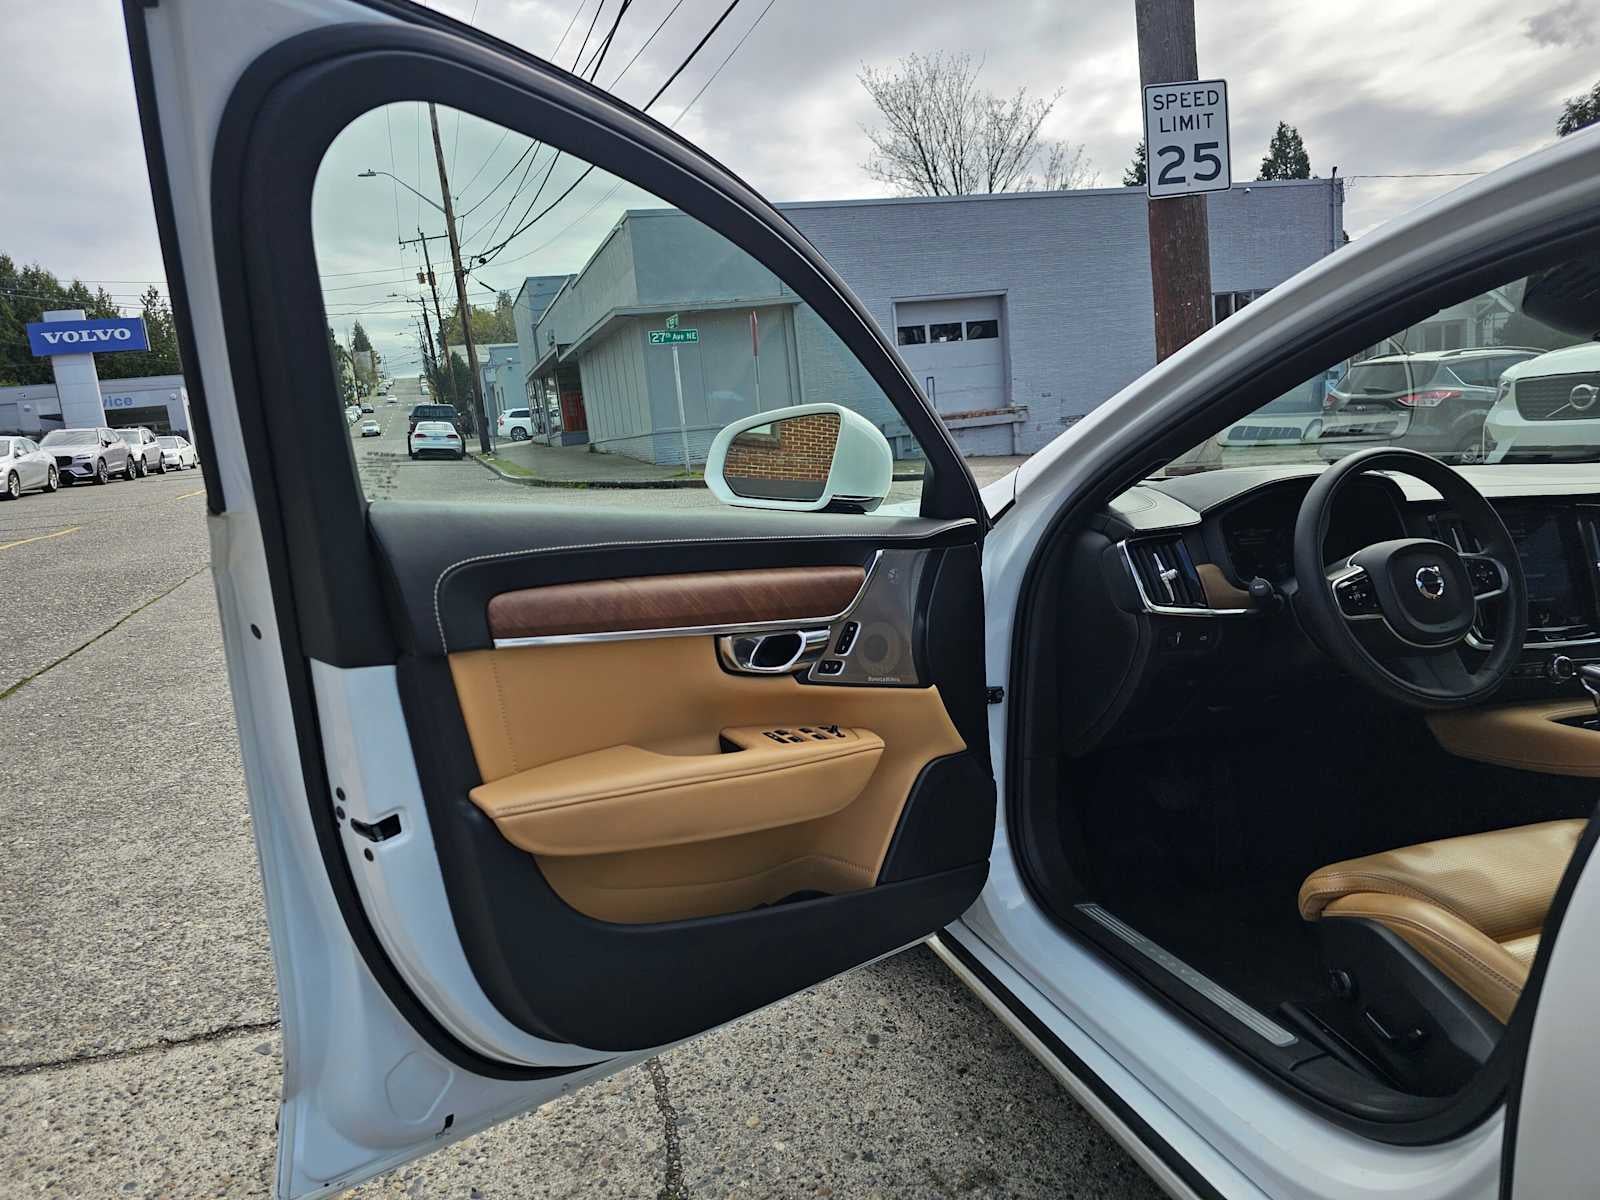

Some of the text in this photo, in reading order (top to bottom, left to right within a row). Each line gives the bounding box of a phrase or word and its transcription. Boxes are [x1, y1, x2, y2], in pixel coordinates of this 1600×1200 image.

[1153, 90, 1219, 111] SPEED
[1160, 113, 1214, 133] LIMIT
[1157, 141, 1222, 185] 25
[40, 328, 131, 344] VOLVO
[651, 332, 671, 343] 27th
[686, 331, 697, 340] NE
